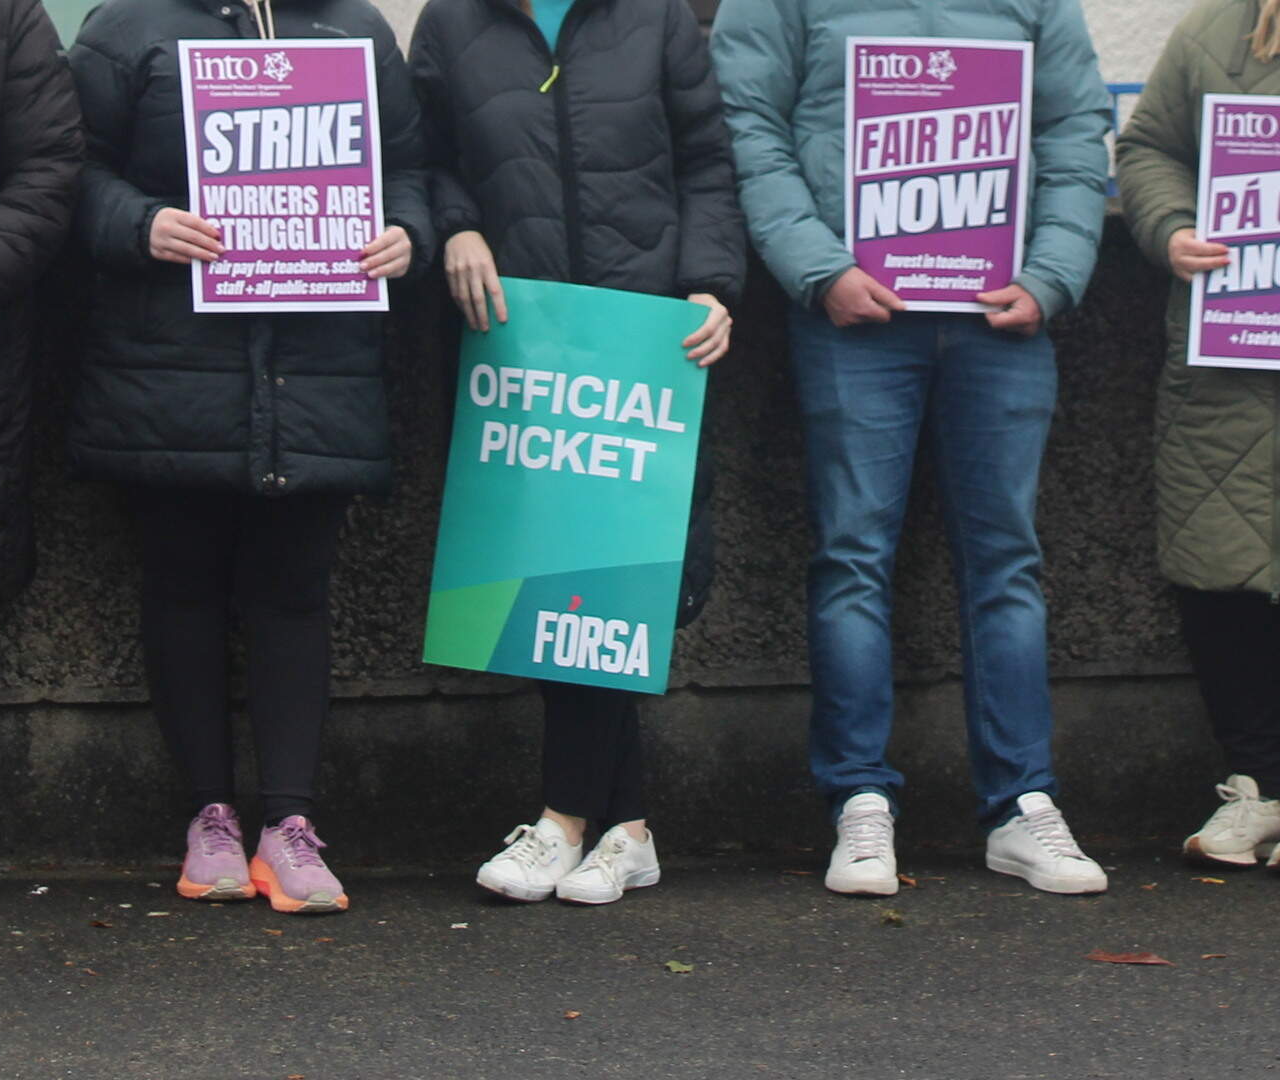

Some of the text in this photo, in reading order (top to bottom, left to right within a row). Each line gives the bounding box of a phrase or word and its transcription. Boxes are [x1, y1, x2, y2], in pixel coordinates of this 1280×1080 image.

[194, 51, 259, 81] into
[858, 48, 923, 80] into
[202, 101, 363, 174] STRIKE
[860, 109, 1016, 171] FAIR PAY
[1215, 107, 1279, 138] into
[202, 184, 372, 216] WORKERS ARE
[858, 168, 1011, 240] NOW!
[1212, 178, 1262, 232] PÁ
[215, 279, 368, 298] staff + all public servants!
[231, 261, 256, 277] pay
[254, 260, 274, 275] for
[274, 260, 330, 276] teachers,
[331, 259, 361, 274] scho
[469, 363, 687, 434] OFFICIAL
[479, 421, 658, 482] PICKET
